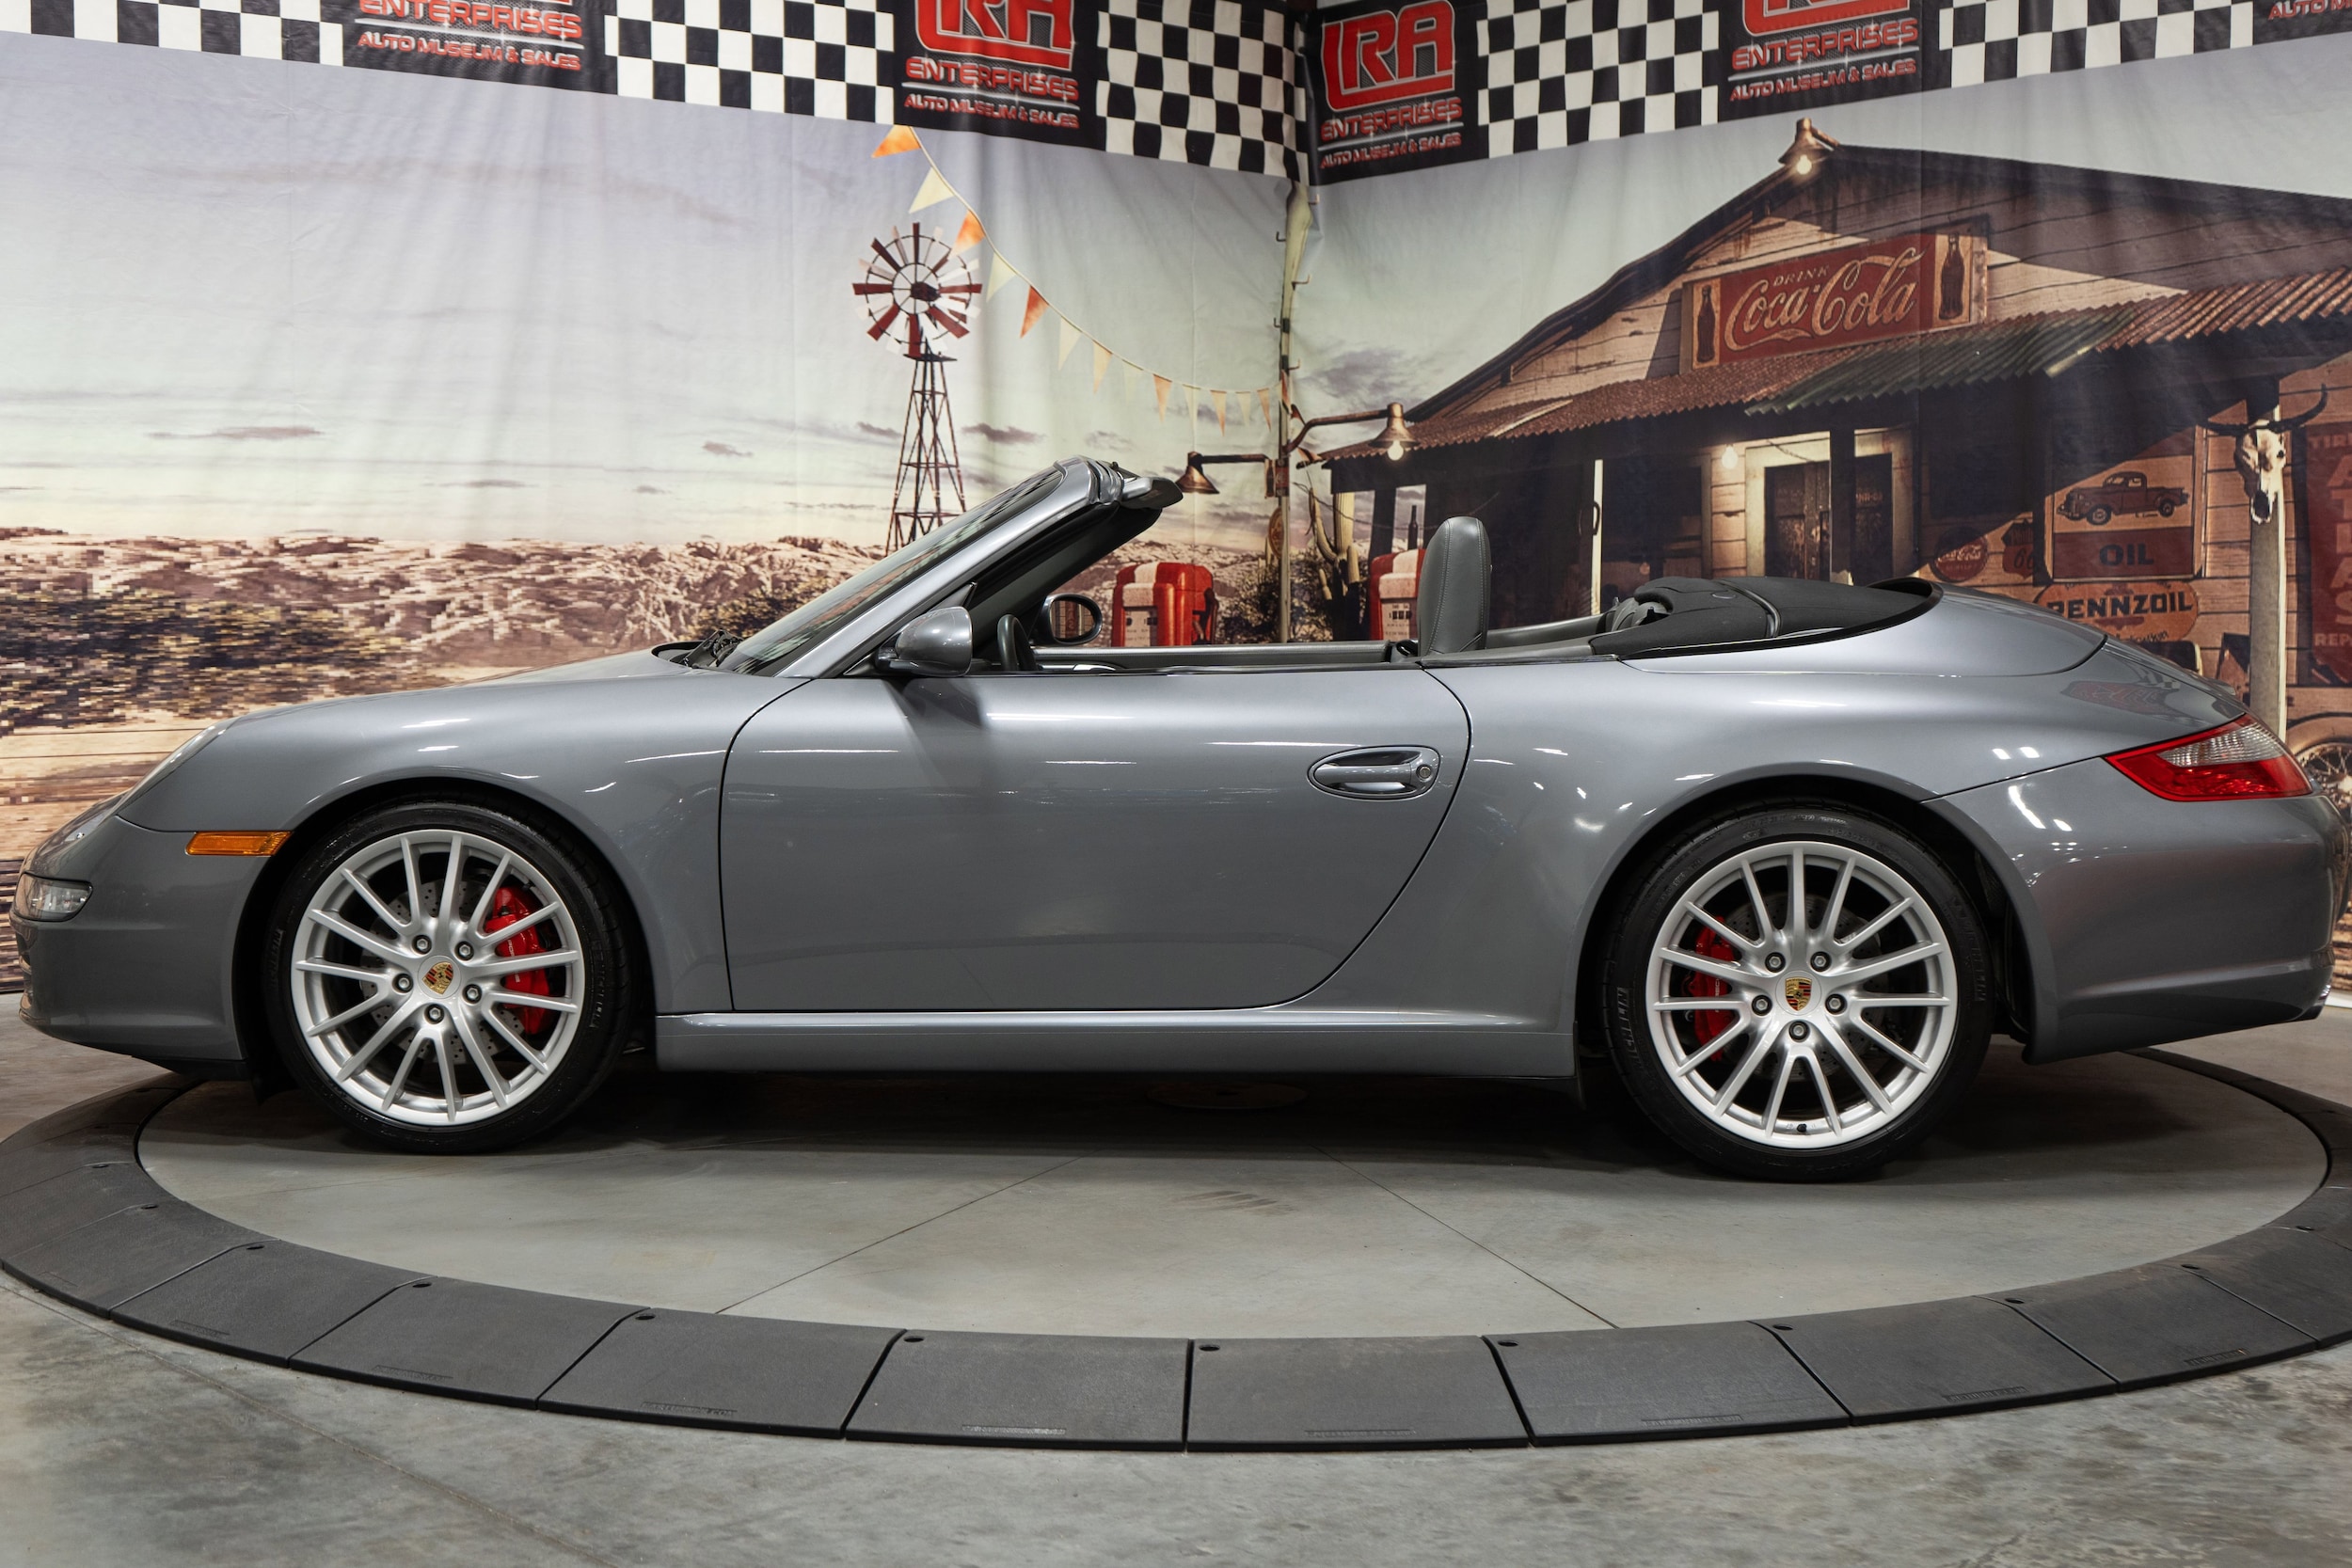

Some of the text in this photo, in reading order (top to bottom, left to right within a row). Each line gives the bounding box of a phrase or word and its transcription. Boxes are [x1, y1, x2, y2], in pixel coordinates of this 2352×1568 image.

[359, 0, 582, 39] ENTERPRISES
[357, 31, 581, 71] AUTO MUSEUM & SALES
[1731, 18, 1918, 71] ENTERPRISES
[905, 55, 1080, 101] ENTERPRISES
[1729, 57, 1916, 102] AUTO MUSEUM & SALES
[903, 93, 1080, 129] AUTO MUSEUM & SALES
[1320, 97, 1463, 141] ENTERPRISES
[1320, 133, 1462, 169] AUTO MUSEUM & SALES
[1772, 264, 1831, 288] DRINK
[1724, 245, 1926, 352] Coca-Cola
[2308, 433, 2352, 450] TIR
[2099, 543, 2154, 566] OIL
[2046, 591, 2194, 619] PENNZOIL
[2314, 632, 2352, 647] REP
